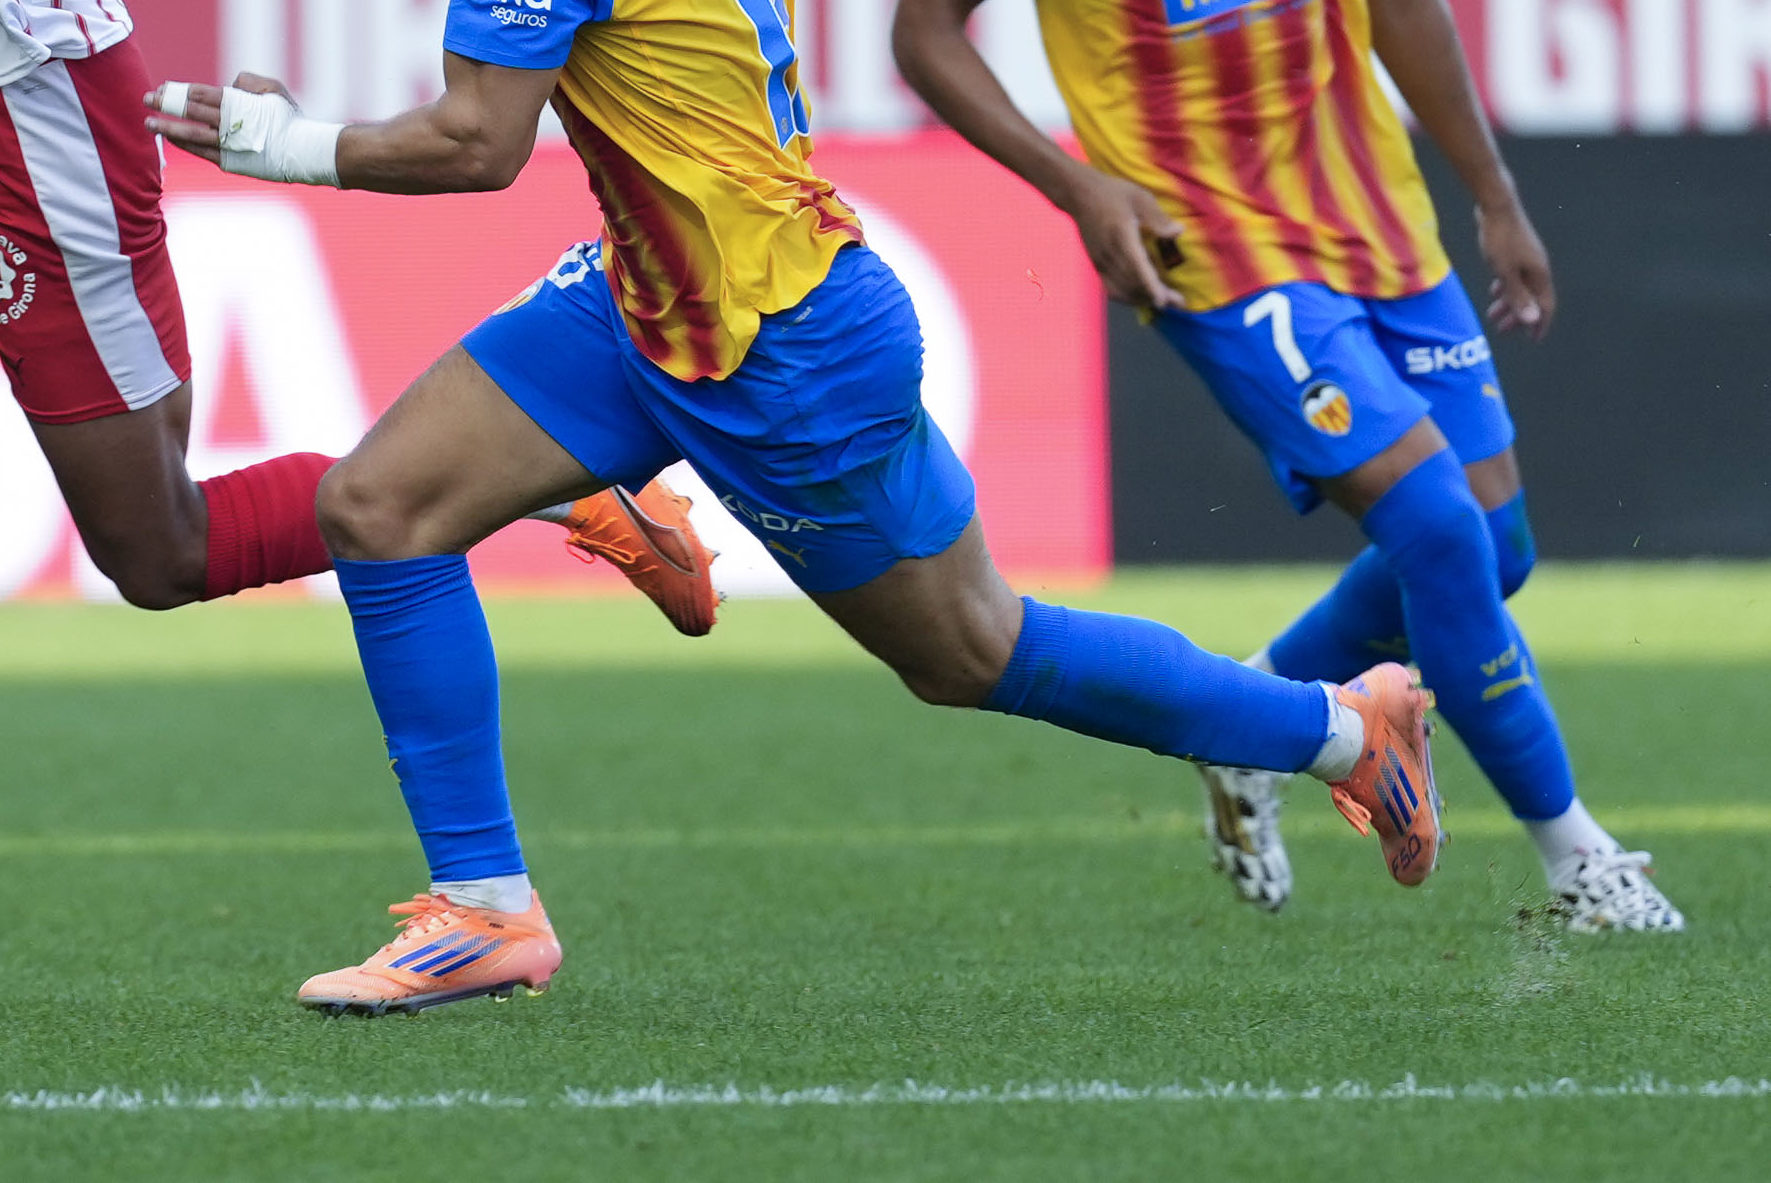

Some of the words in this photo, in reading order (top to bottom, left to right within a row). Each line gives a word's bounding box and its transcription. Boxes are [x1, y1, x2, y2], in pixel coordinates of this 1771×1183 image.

[490, 5, 548, 28] seguros
[8, 272, 36, 320] Girona
[1243, 290, 1312, 384] 7
